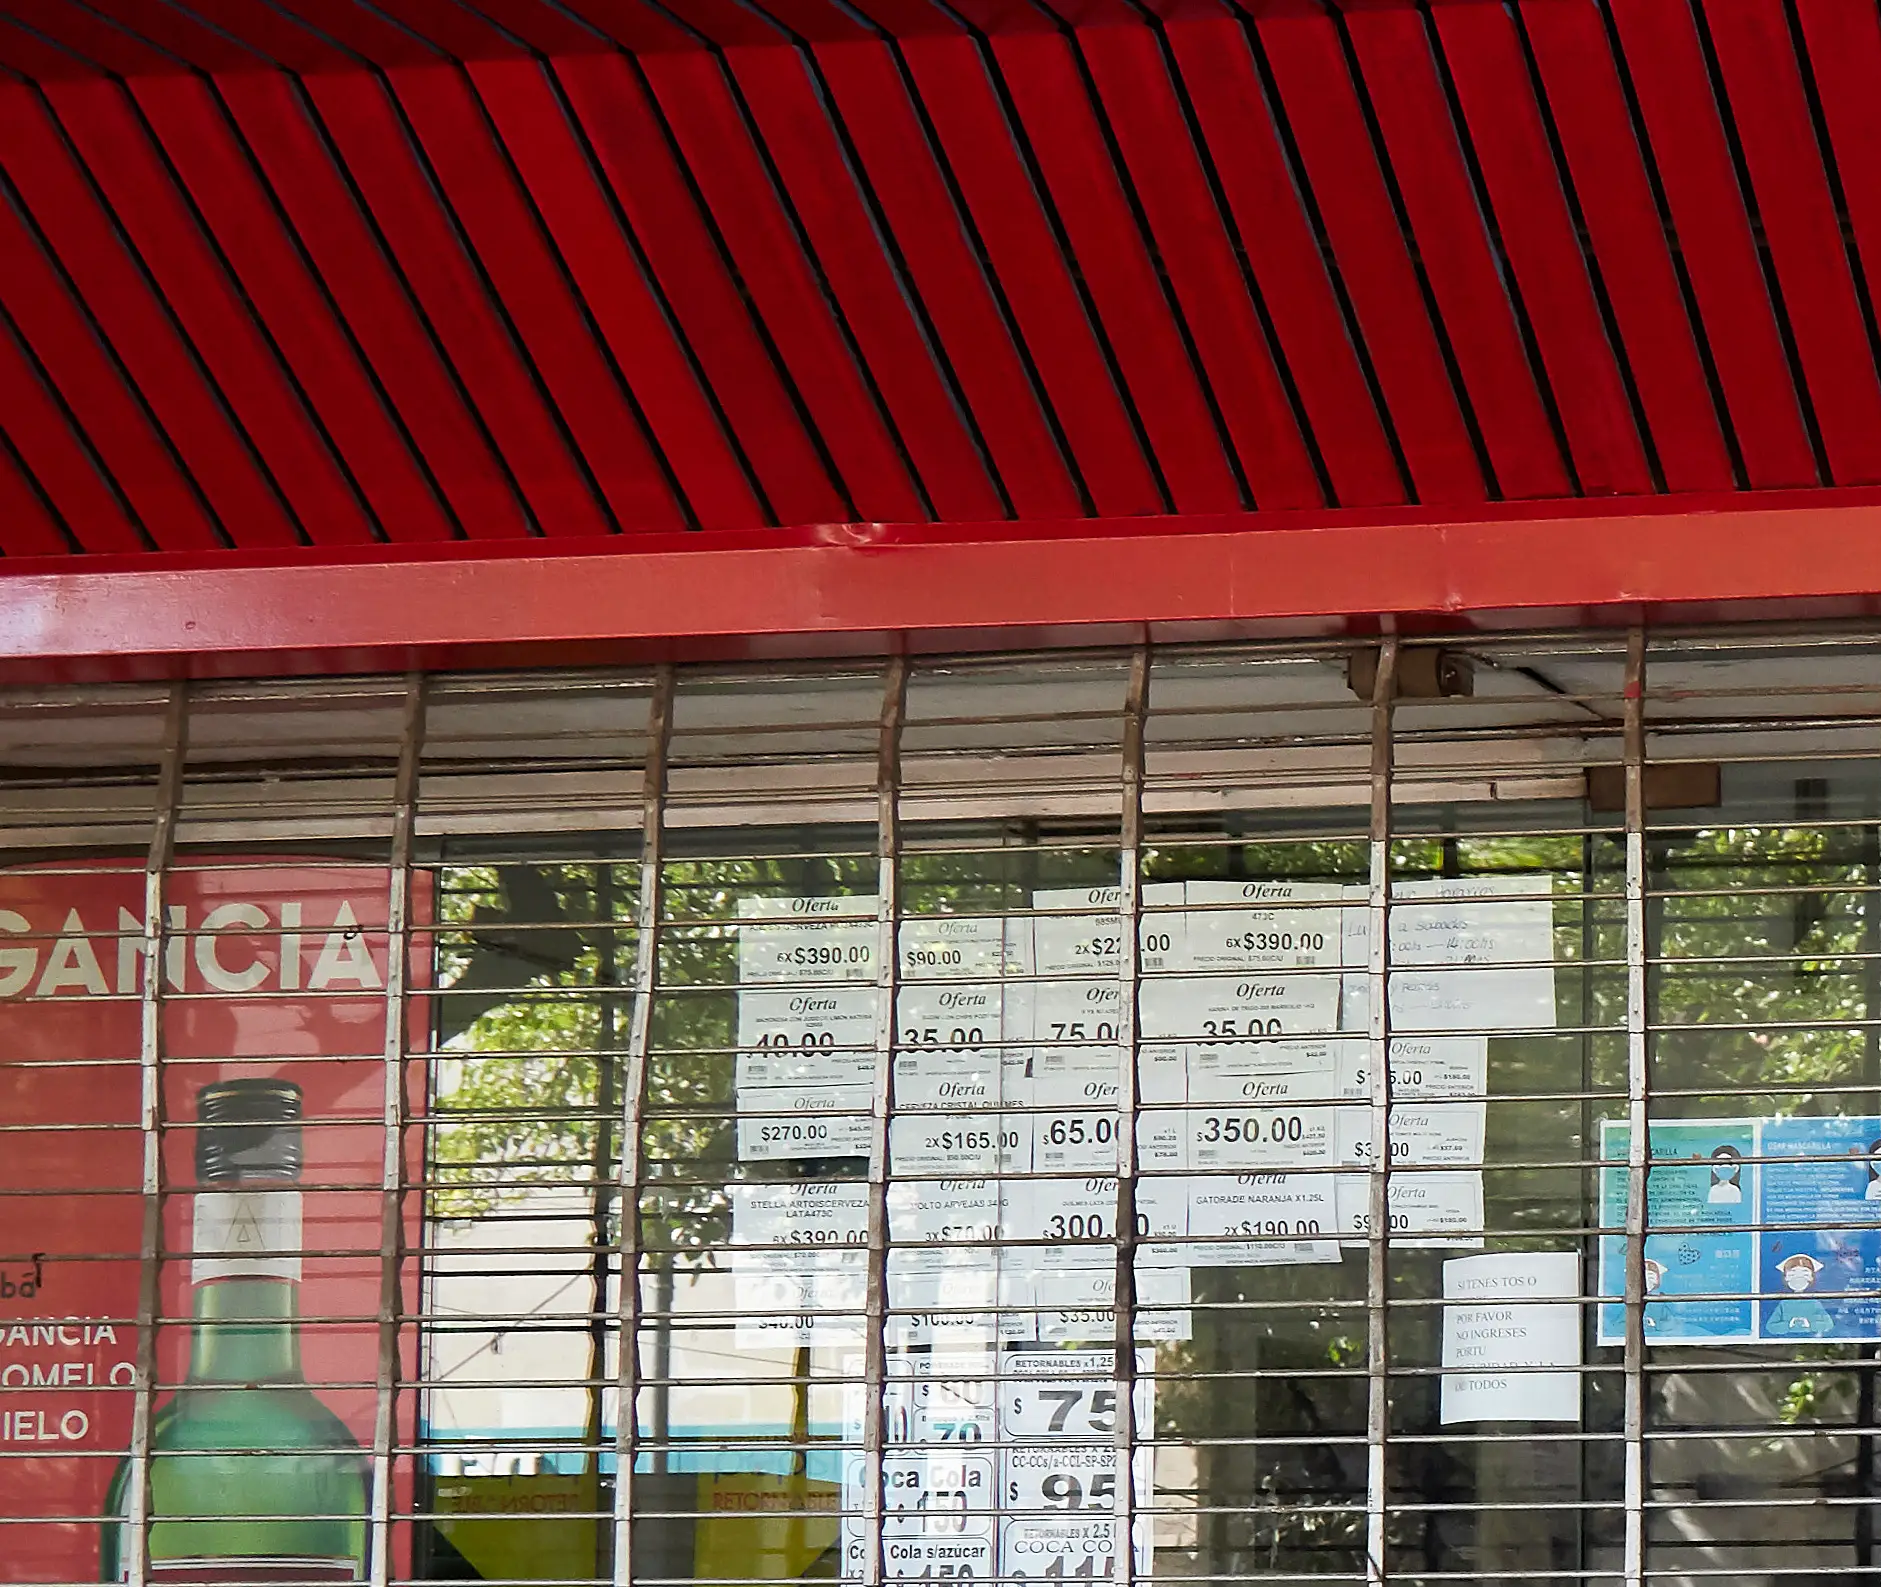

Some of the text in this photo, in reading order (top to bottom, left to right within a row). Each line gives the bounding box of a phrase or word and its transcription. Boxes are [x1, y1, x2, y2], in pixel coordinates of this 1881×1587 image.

[1243, 883, 1292, 898] Oferta
[791, 897, 839, 913] Oferta
[938, 921, 978, 934] Oferta
[907, 950, 961, 967] $90.00
[938, 991, 987, 1009] Oferta
[1236, 983, 1286, 1000] Oferta
[789, 996, 838, 1014] Oferta
[1391, 1042, 1432, 1055] Oferta
[939, 1081, 986, 1098] Oferta
[1242, 1081, 1289, 1100] Oferta
[794, 1097, 836, 1110] Oferta
[760, 1124, 828, 1142] $270.00
[1196, 1116, 1303, 1143] $350.00
[1237, 1172, 1287, 1187] Oferta
[1043, 1213, 1150, 1239] $300.0
[1240, 1219, 1320, 1237] $19000
[0, 1315, 117, 1347] ANCIA
[1037, 1390, 1117, 1432] 75
[1041, 1473, 1117, 1512] 95
[889, 1543, 986, 1559] Cola s/azúcar
[1014, 1540, 1075, 1554] COCA
